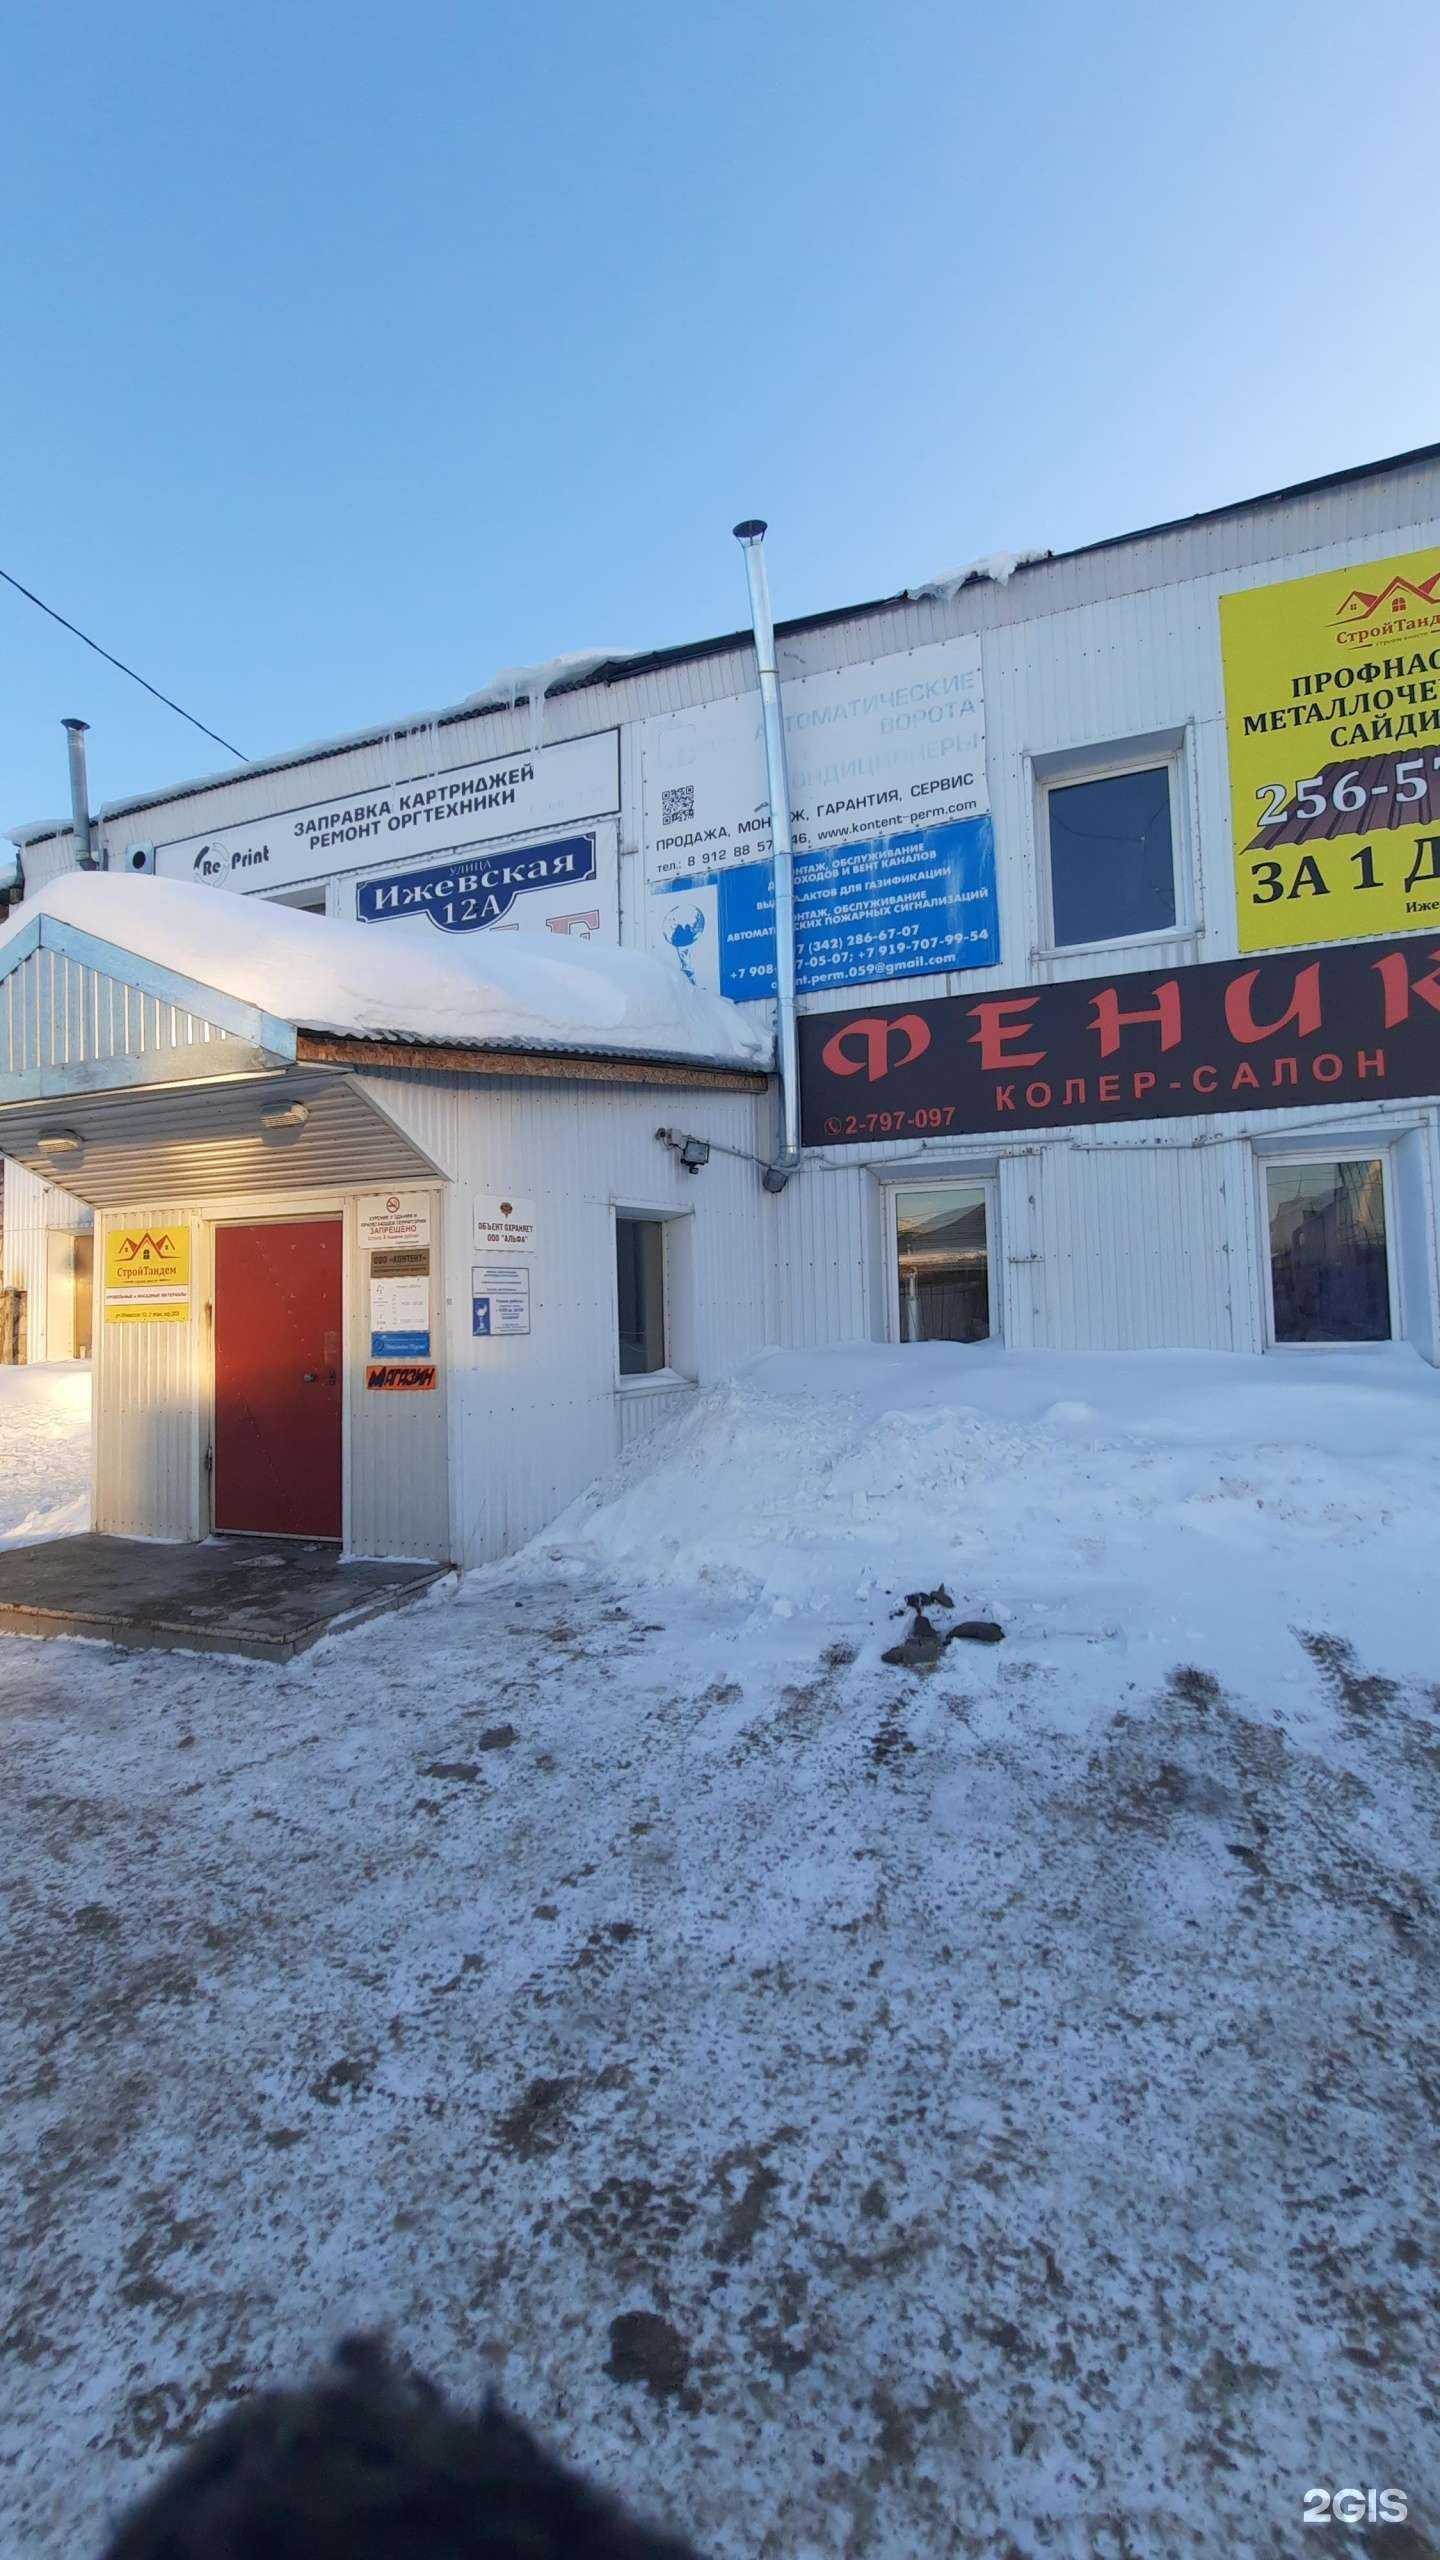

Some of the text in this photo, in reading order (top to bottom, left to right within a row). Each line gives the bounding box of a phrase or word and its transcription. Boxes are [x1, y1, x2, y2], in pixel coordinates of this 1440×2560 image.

[754, 671, 975, 741] АТОМАТИЧЕСКИЕ
[880, 698, 976, 735] ВОРОТА
[1243, 679, 1440, 736] МЕТАЛЛОЧЕ
[1330, 709, 1440, 747] САЙДИ
[792, 733, 977, 788] ОНДИЦИОНЕРЫ
[294, 763, 534, 837] ЗАПРАВКА КАРТРИДЖЕЙ
[1255, 757, 1440, 828] 256-5
[309, 789, 515, 850] РЕМОНТ ОРГТЕХНИКИ
[656, 772, 974, 852] ПРОДАЖА, МОНЖ, ГАРАНТИЯ, СЕРВИС
[687, 856, 695, 867] 8
[702, 850, 727, 864] 912
[734, 845, 750, 858] 88
[757, 840, 773, 853] 57
[817, 800, 976, 841] www.kontent-perm.com
[203, 845, 270, 876] Re Print
[449, 860, 492, 875] УЛИЦА
[768, 850, 937, 892] ДОХОДОВ И ВЕНТ КАНАЛОВ
[794, 843, 925, 877] НТАЖ, ОБСЛУЖИВАНИЕ
[1251, 853, 1331, 904] ЗА
[1350, 845, 1384, 890] 1
[374, 854, 574, 911] Ижевская
[840, 883, 862, 896] ДЛЯ
[864, 865, 951, 891] ГАЗИФИКАЦИИ
[442, 894, 501, 925] 12А
[794, 890, 927, 922] НТАЖ, ОБСЛУЖИВАНИЕ
[825, 906, 891, 925] ПОЖАРНЫХ
[894, 887, 989, 914] СИГНАЛИЗАЦИЙ
[730, 928, 989, 980] +7 908-7-05-07; +7 919-707-99-54
[808, 937, 843, 956] (342)
[846, 924, 920, 946] 286-67-07
[821, 948, 1440, 1083] ФЕНИК
[996, 1049, 1386, 1112] КОЛЕР-САЛОН
[844, 1106, 956, 1135] 2-797-097
[370, 1224, 417, 1234] ЗАПРЕЩЕНО
[478, 1222, 533, 1233] ОБЪЕКТ ОХРАНЯЕТ
[487, 1234, 500, 1242] ООО
[117, 1266, 176, 1279] СтройТандем
